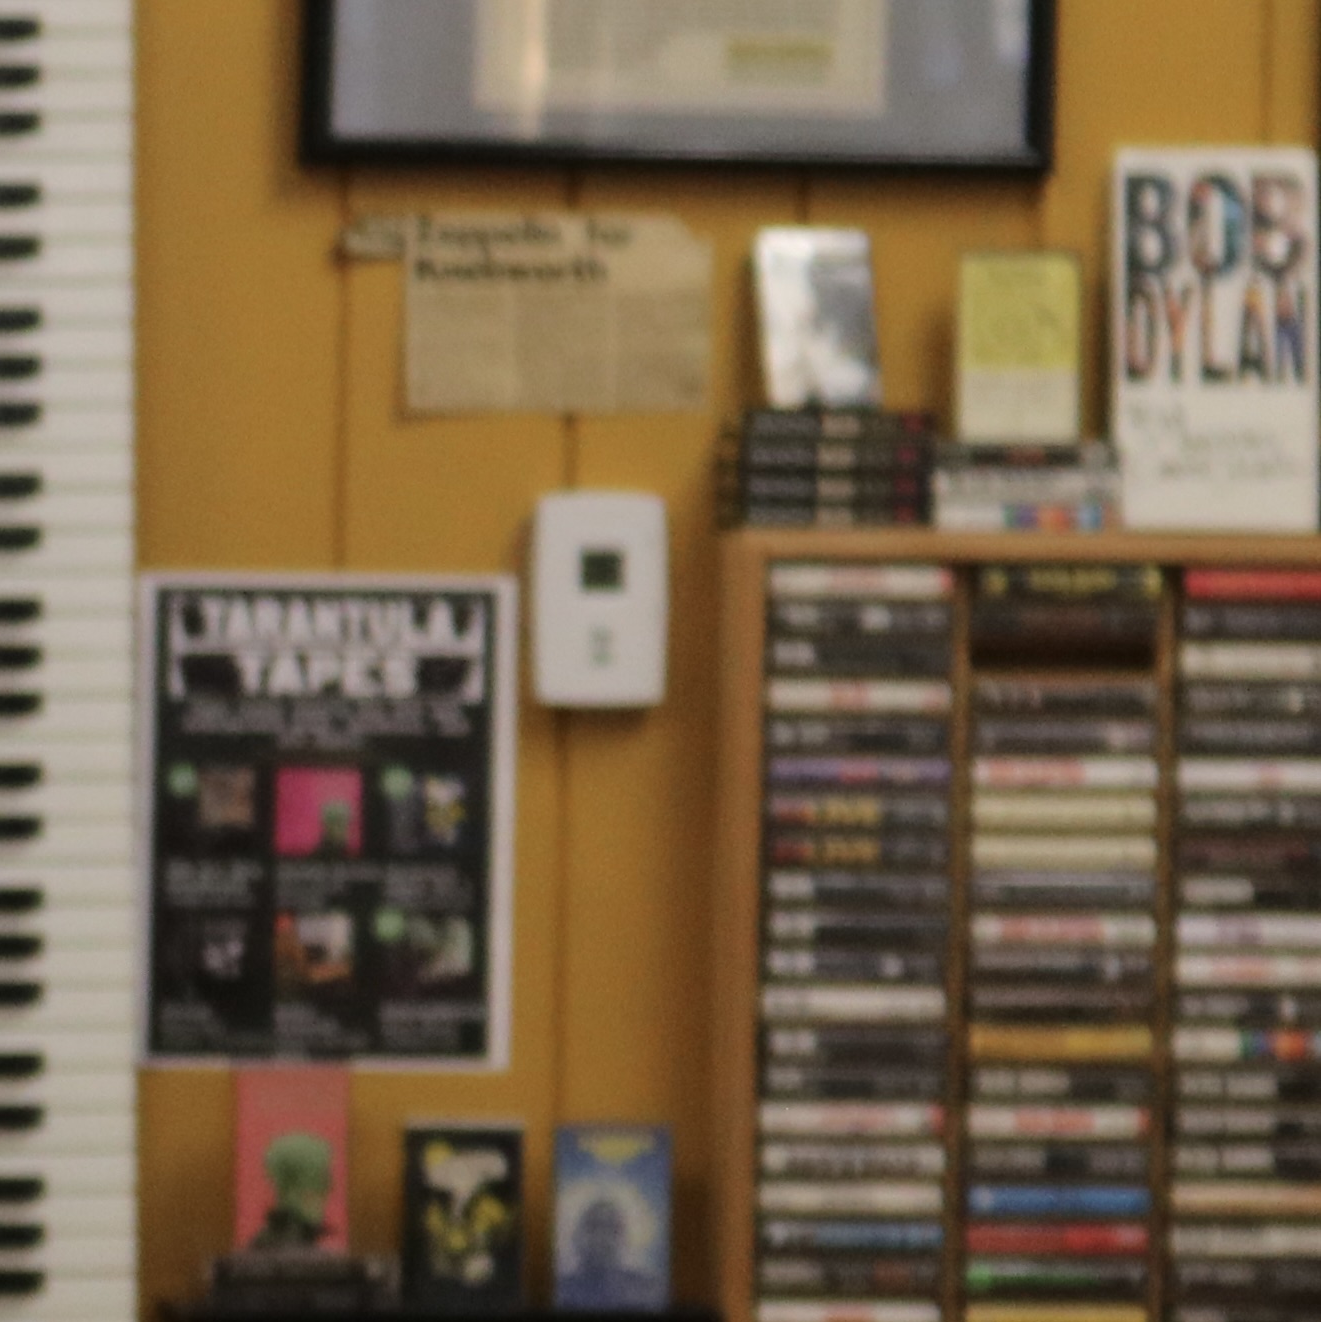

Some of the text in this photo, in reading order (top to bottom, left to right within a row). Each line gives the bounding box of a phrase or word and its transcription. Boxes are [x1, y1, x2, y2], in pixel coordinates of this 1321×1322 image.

[1124, 173, 1305, 276] BOB
[1124, 284, 1307, 382] DYLAN
[199, 596, 467, 646] TARANTULA
[239, 652, 419, 699] TAPES
